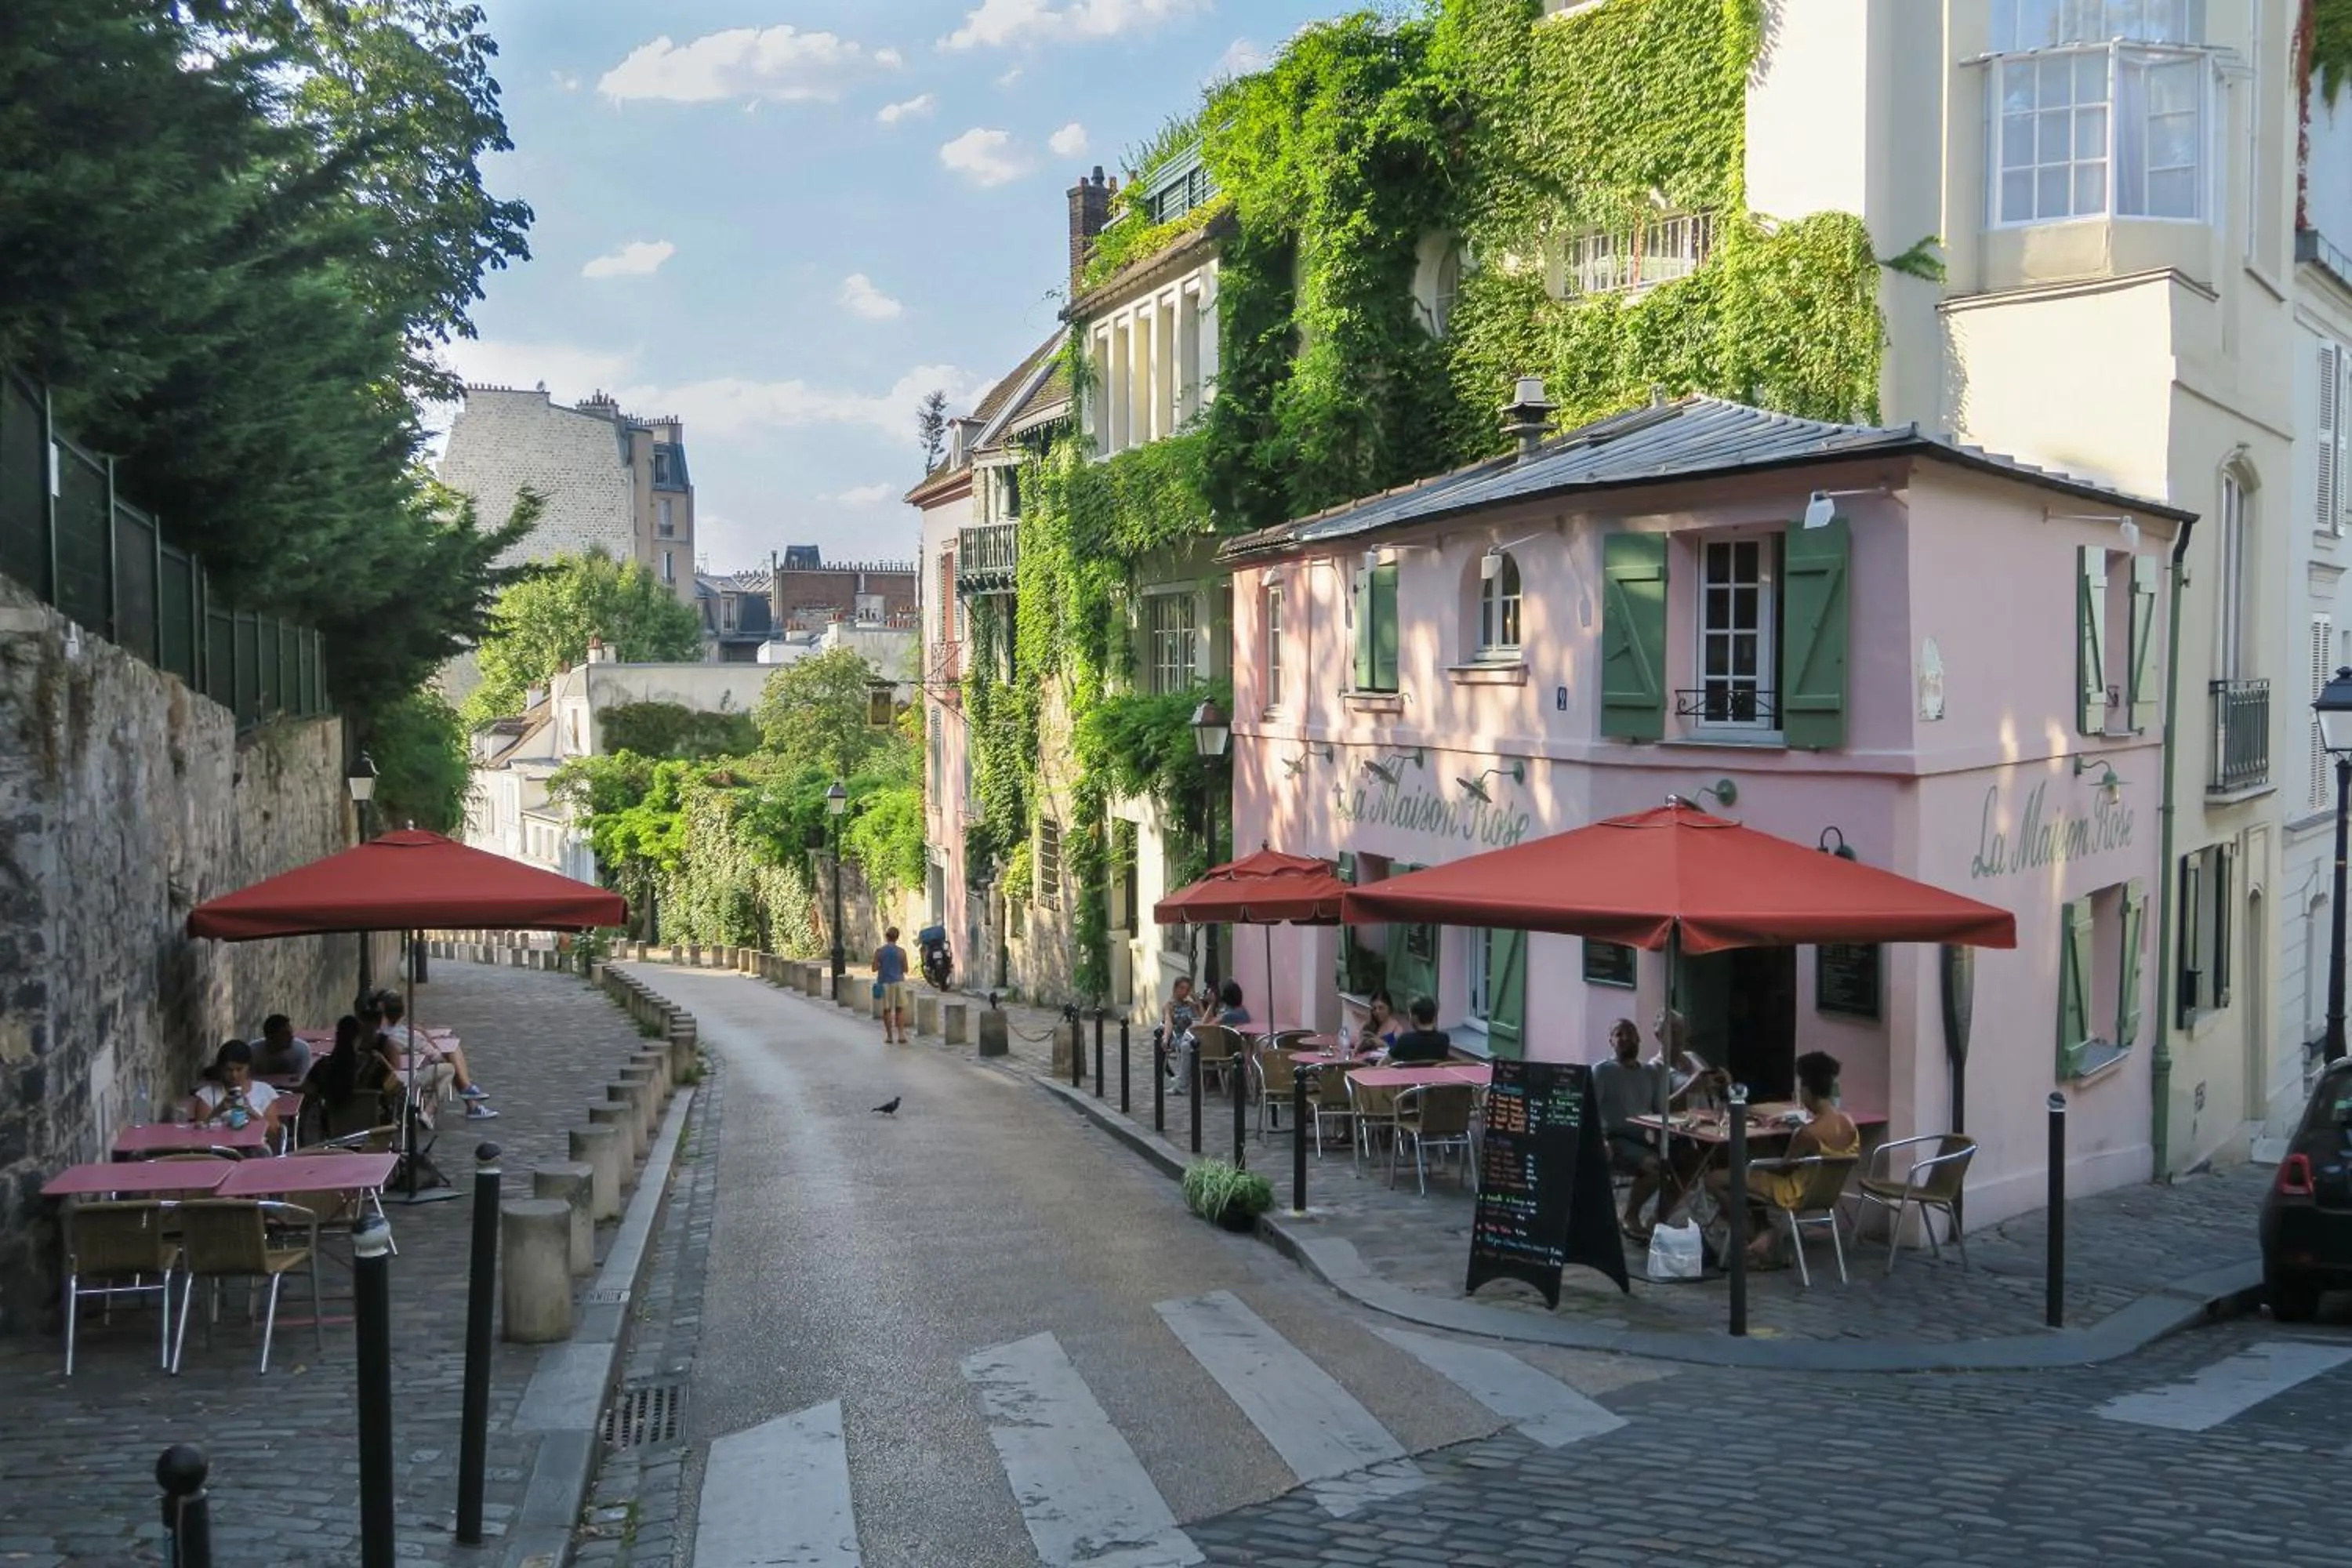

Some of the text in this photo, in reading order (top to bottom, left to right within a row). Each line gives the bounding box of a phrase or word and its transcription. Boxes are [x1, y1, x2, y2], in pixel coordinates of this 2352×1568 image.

[1335, 753, 1366, 822] La
[1369, 755, 1458, 837] Maison
[1972, 779, 2134, 879] La Maison Rose
